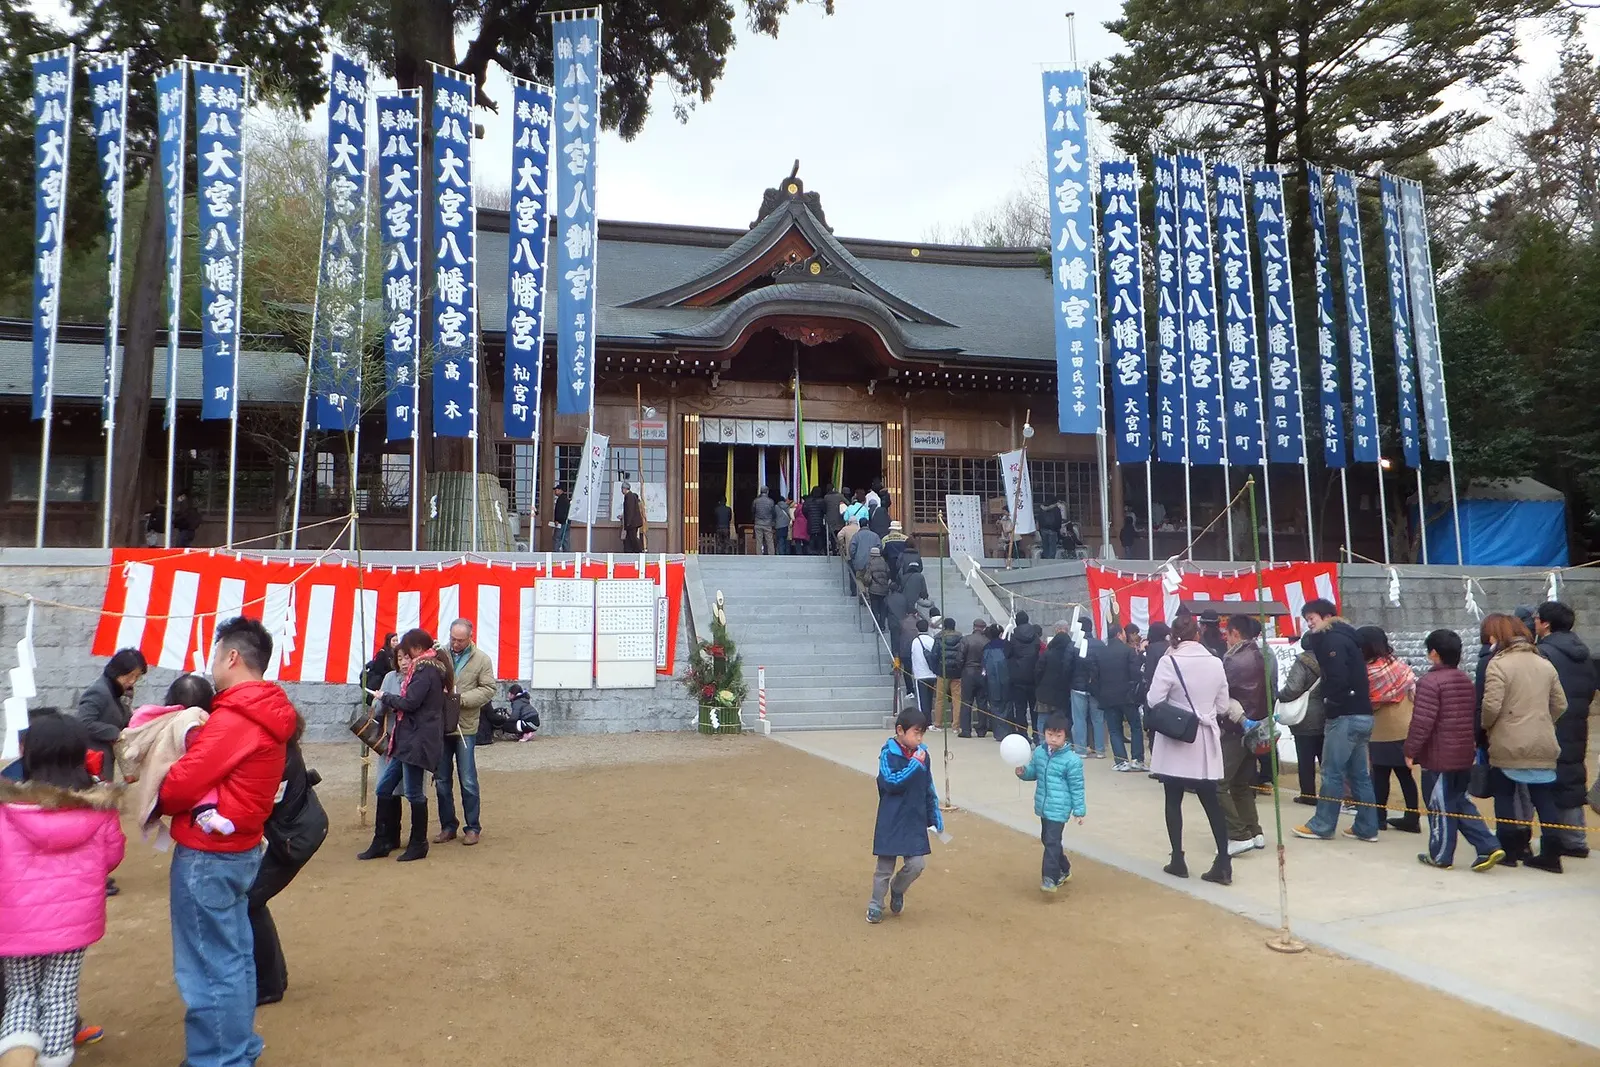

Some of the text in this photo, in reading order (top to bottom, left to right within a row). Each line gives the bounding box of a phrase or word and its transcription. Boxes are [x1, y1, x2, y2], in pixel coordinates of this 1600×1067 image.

[199, 84, 238, 110] 奉納
[333, 70, 366, 104] 奉納
[436, 87, 468, 118] 奉納
[515, 99, 549, 128] 奉納
[1048, 85, 1083, 107] 奉納
[380, 108, 414, 132] 奉納
[1103, 172, 1133, 192] 奉納
[1155, 166, 1173, 190] 奉納
[1180, 166, 1203, 189] 奉納
[1217, 174, 1240, 196] 奉納
[1254, 180, 1280, 200] 奉納
[203, 140, 237, 335] 大宮八幡宮
[326, 131, 361, 338] 大宮八幡宮
[384, 163, 414, 352] 大宮八幡宮
[437, 147, 468, 348] 大宮八幡宮
[511, 157, 544, 351] 大宮八幡宮
[1053, 139, 1091, 329] 大宮八幡宮
[1109, 219, 1142, 386] 大宮八幡宮
[1158, 216, 1178, 385] 大宮八幡宮
[1185, 216, 1212, 388] 大宮八幡宮
[1222, 223, 1250, 390] 大宮八幡宮
[1263, 228, 1291, 391] 大宮八幡宮
[1313, 228, 1338, 394] 大宮八幡宮
[1343, 231, 1367, 392] 大宮八幡宮
[1388, 235, 1412, 393] 大宮八幡宮
[1411, 239, 1435, 395] 大宮八幡宮
[214, 340, 230, 401] 上町
[444, 361, 462, 420] 高木
[1070, 340, 1086, 417] 平田氏子中
[1124, 397, 1141, 448] 大宮町
[1161, 396, 1174, 447] 大日町
[1195, 399, 1211, 450] 末広町
[1234, 401, 1249, 450] 新町
[1274, 395, 1291, 448] 明石町
